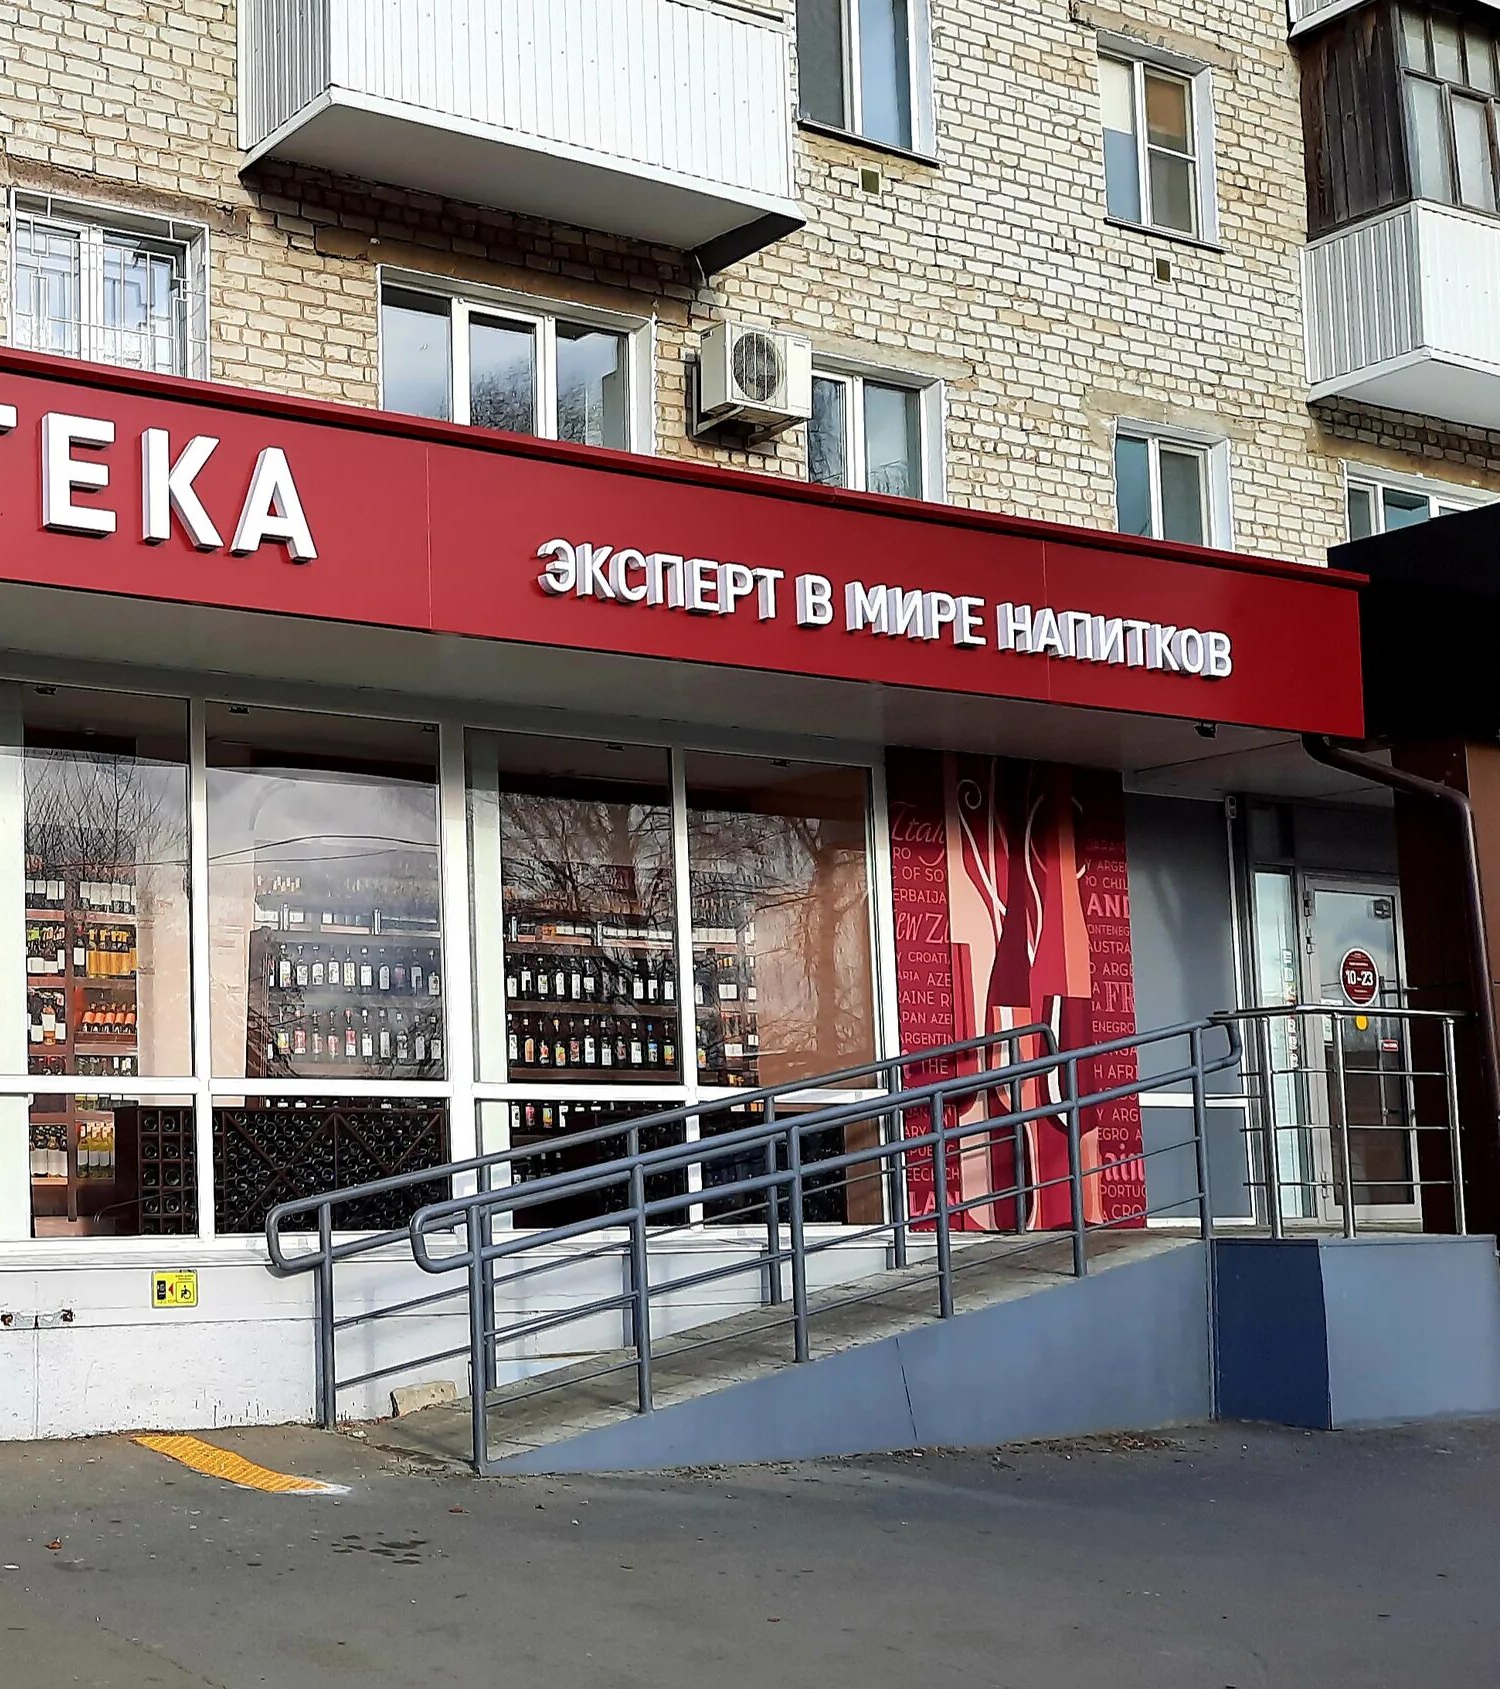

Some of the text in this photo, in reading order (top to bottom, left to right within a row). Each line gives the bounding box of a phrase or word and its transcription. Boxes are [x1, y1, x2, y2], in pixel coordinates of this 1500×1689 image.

[537, 538, 1233, 678] ЭКСПЕРТ В МИРЕ НАПИТКОВ
[902, 866, 920, 880] OF
[925, 867, 947, 882] SO
[1097, 860, 1127, 873] ARGE
[908, 951, 950, 965] CROATI
[1346, 969, 1373, 986] 10-23
[900, 1011, 953, 1025] PAN AZE
[1092, 1020, 1135, 1035] ENEGRO
